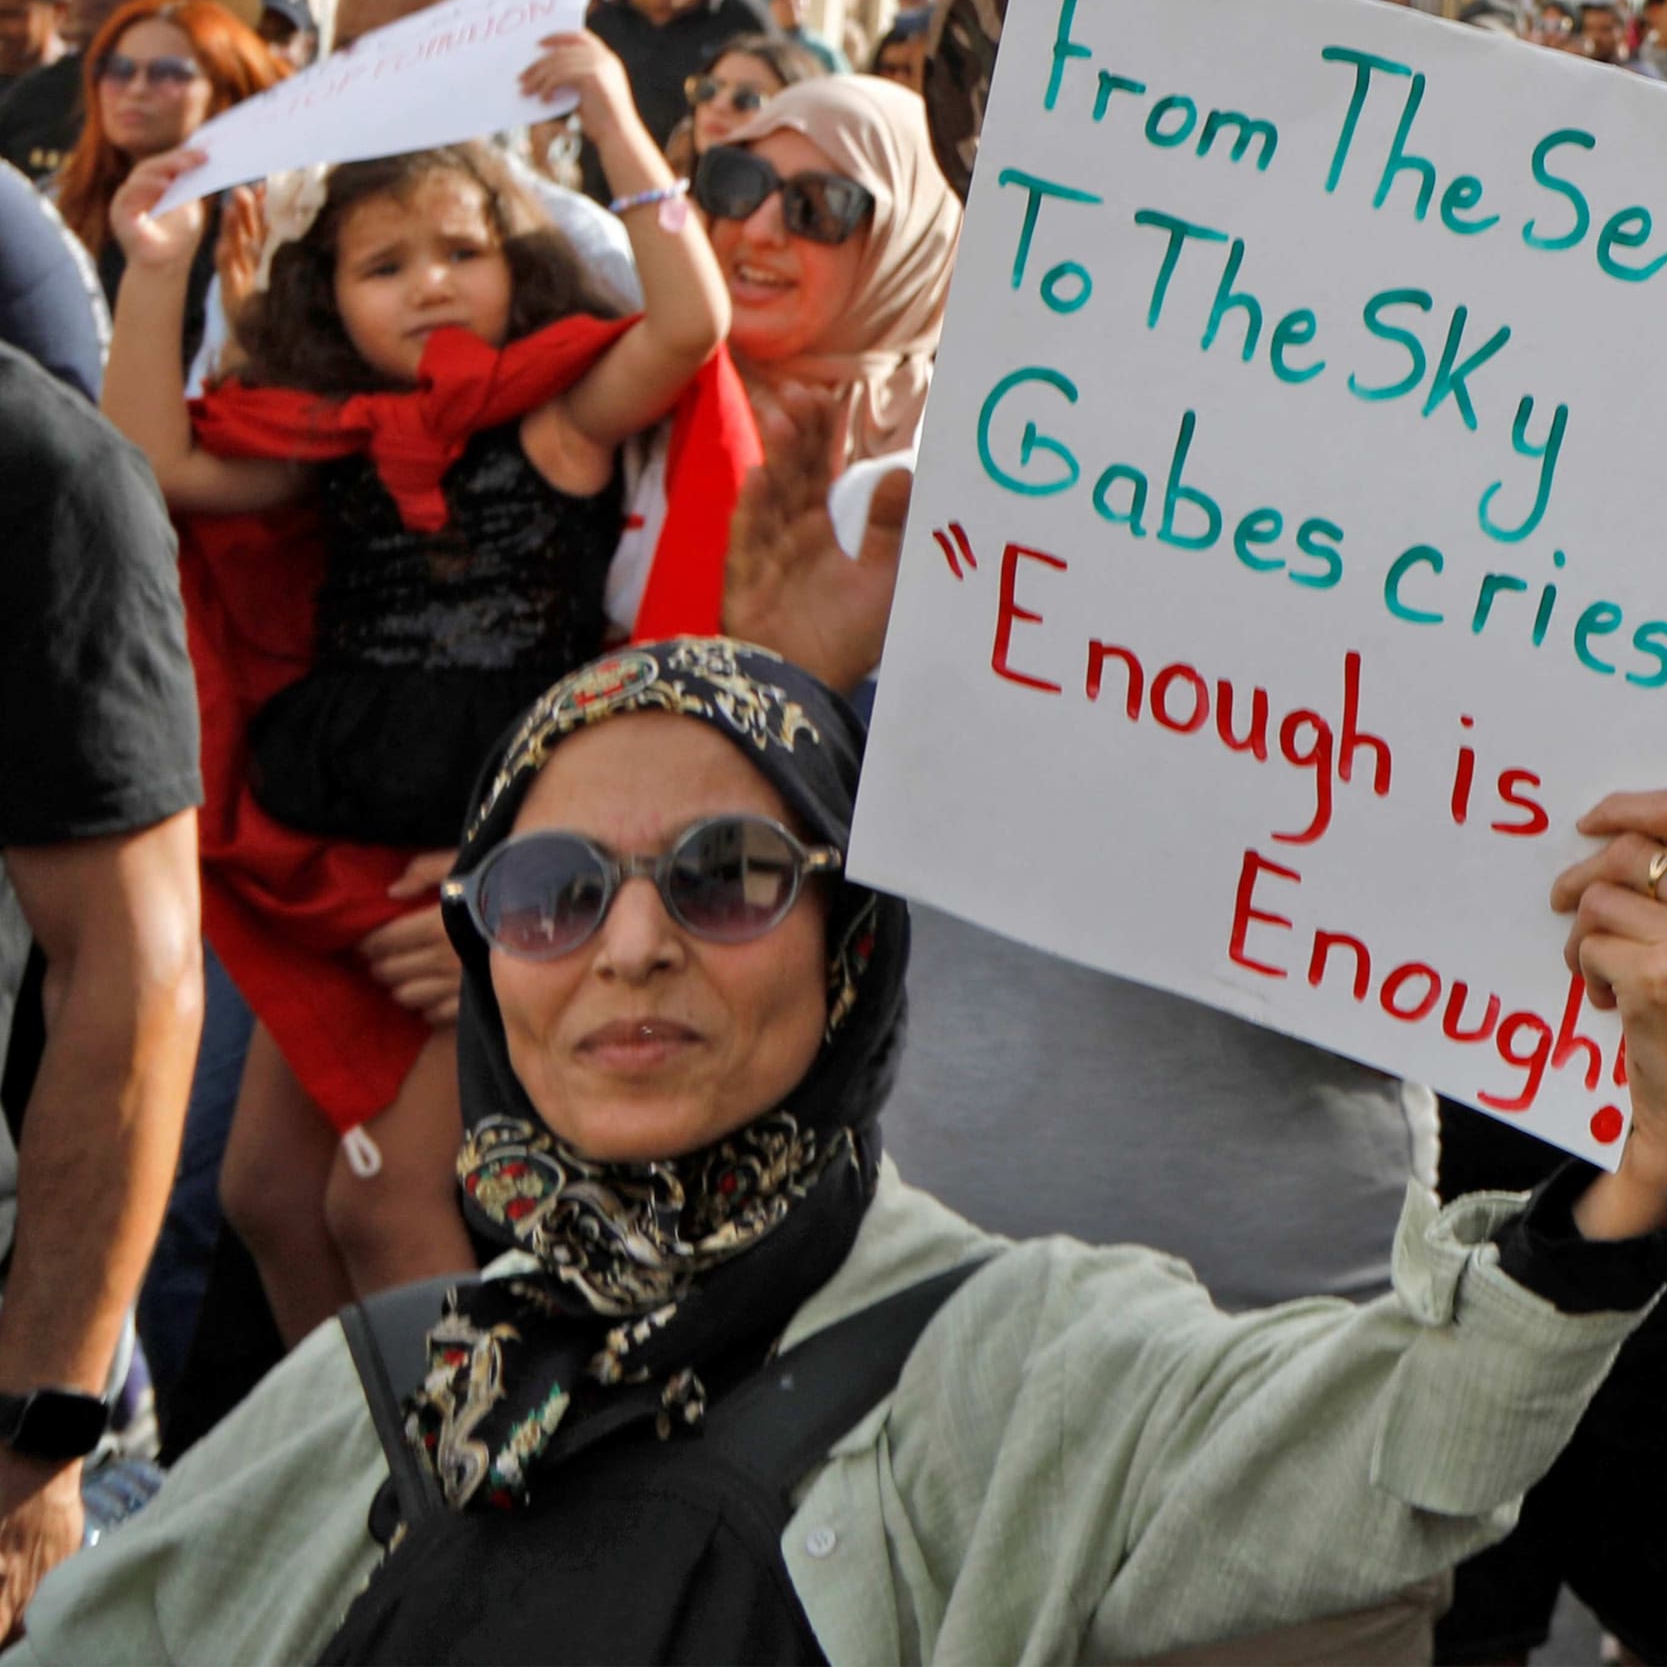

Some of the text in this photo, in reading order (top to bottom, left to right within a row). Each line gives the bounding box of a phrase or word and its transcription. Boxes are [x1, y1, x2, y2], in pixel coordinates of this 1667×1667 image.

[1321, 45, 1502, 237] The
[998, 168, 1103, 316] To
[1134, 208, 1327, 385] The
[977, 365, 1346, 590] Gabes
[1450, 715, 1550, 837] is
